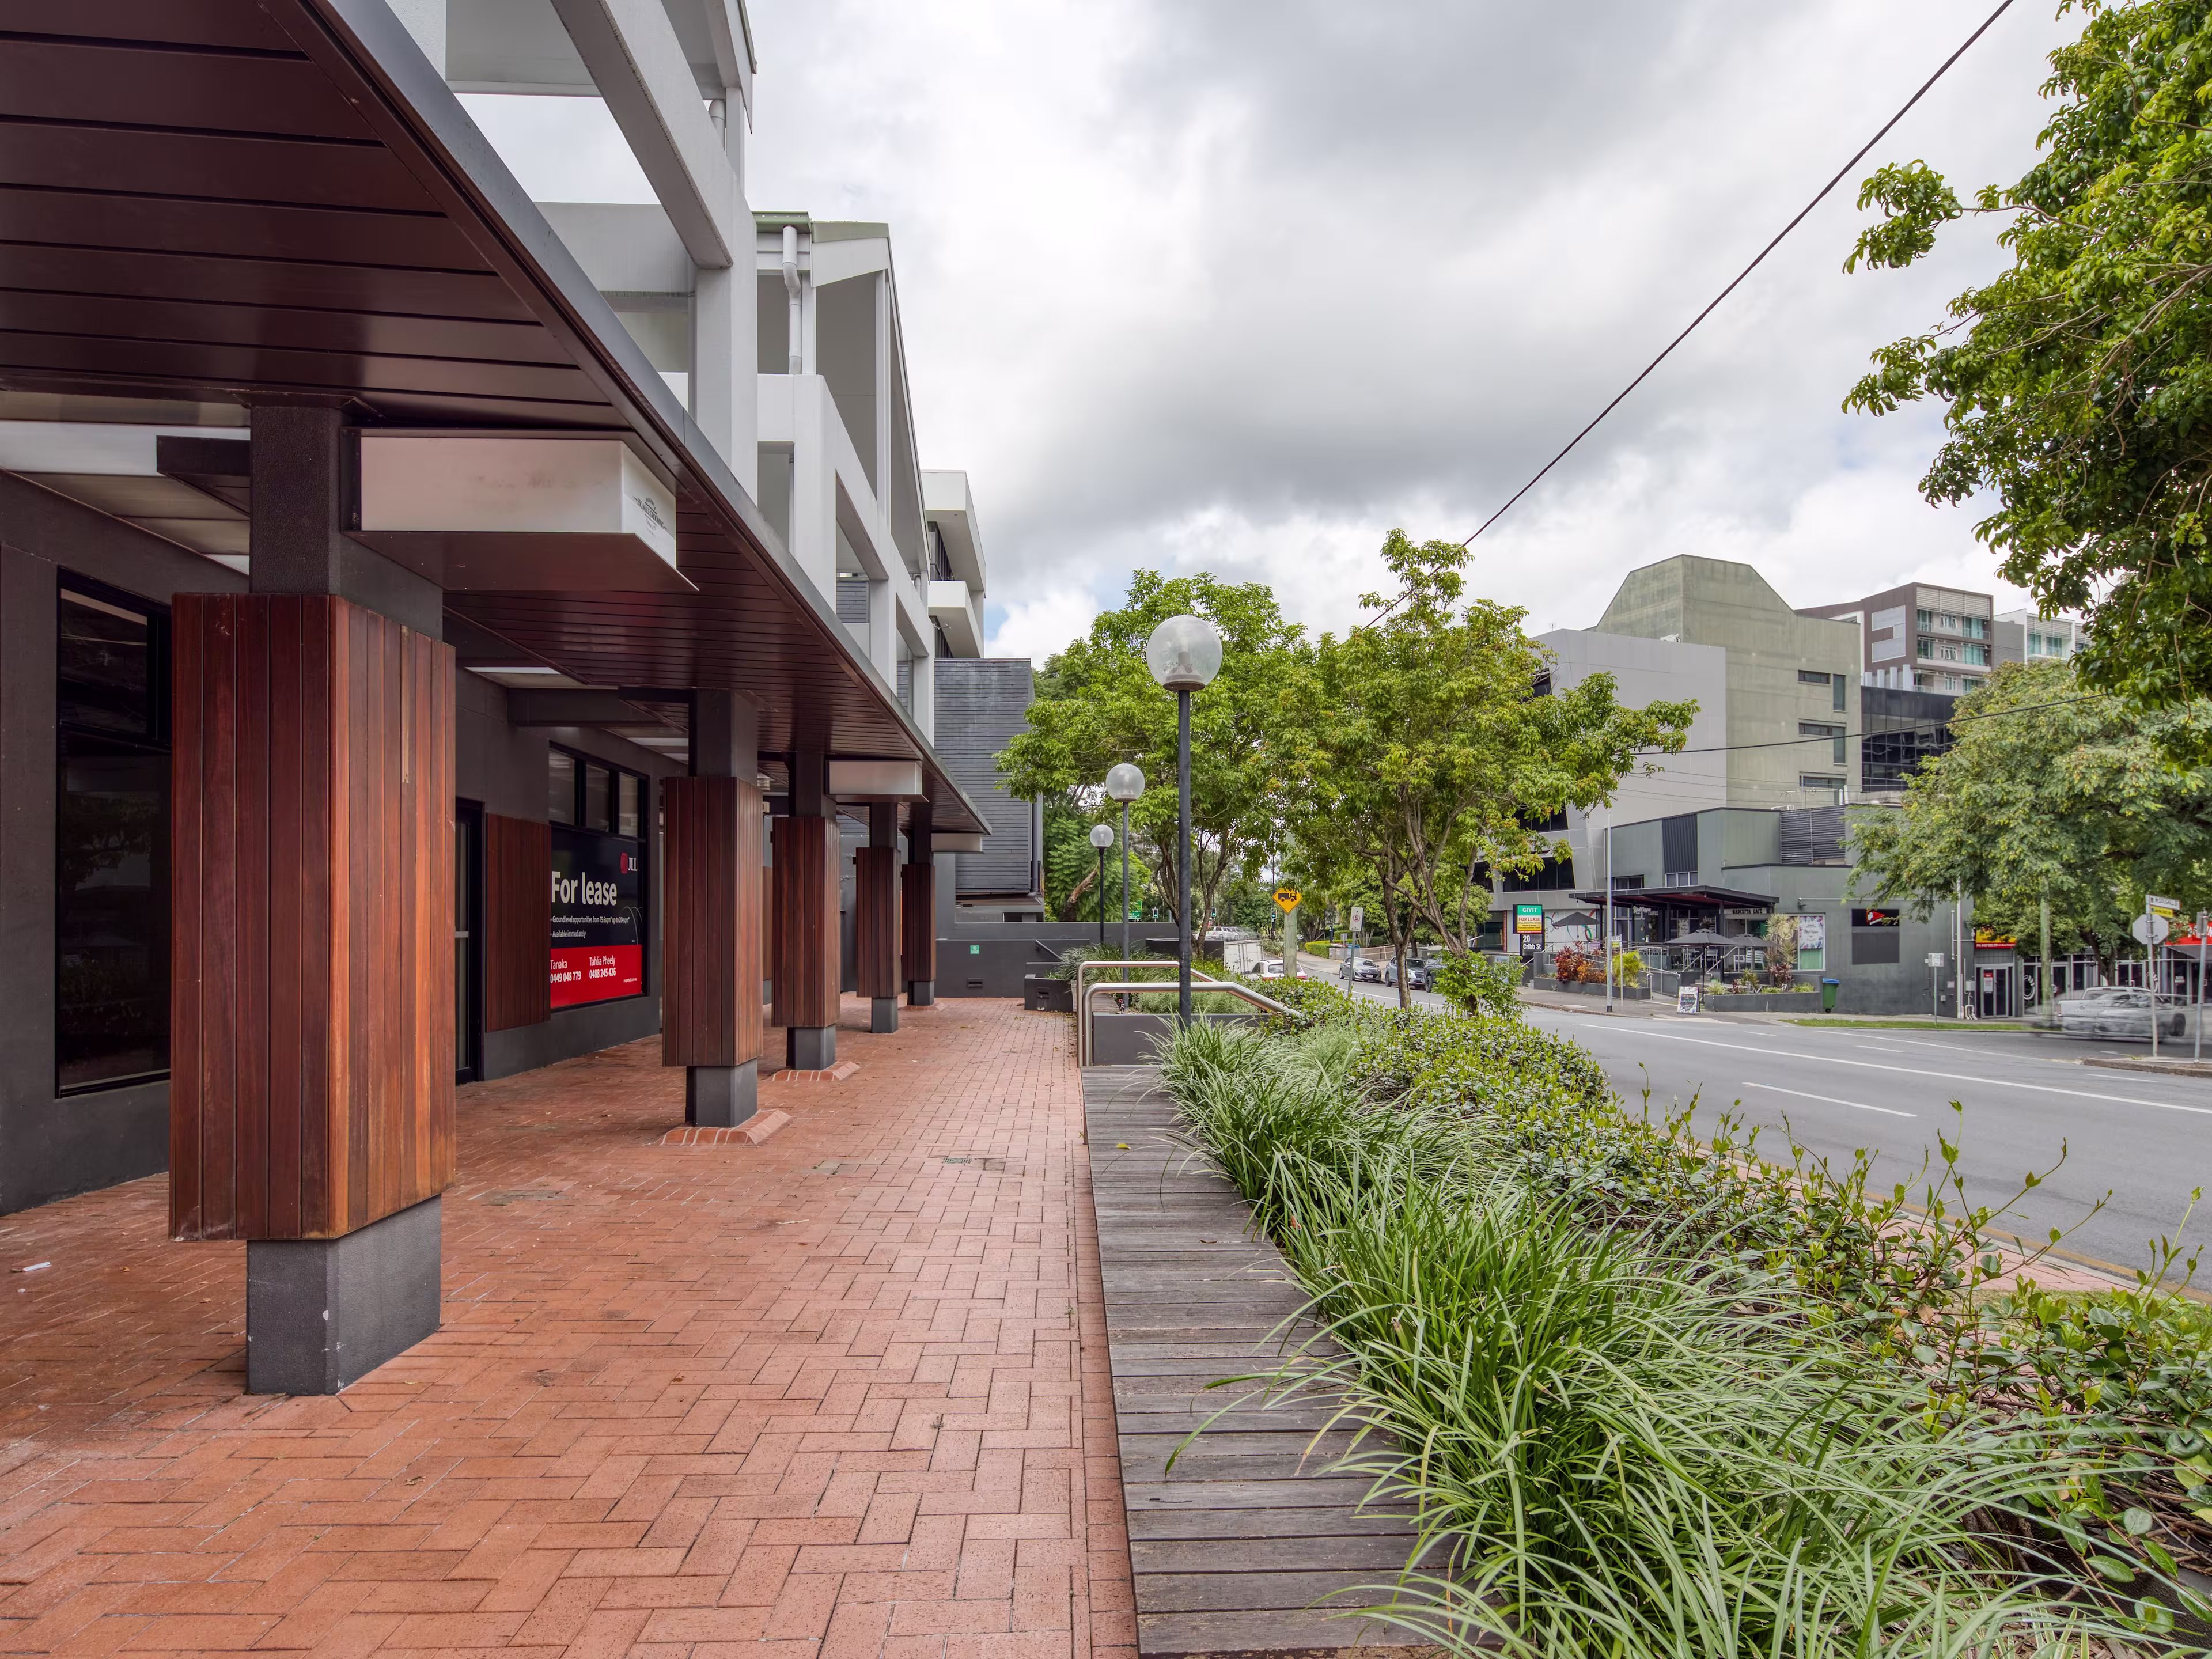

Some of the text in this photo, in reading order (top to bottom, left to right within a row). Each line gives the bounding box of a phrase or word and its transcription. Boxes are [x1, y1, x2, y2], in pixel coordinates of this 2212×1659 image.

[627, 857, 638, 871] JLL
[551, 870, 617, 906] For lease
[573, 916, 592, 924] opportunities
[567, 930, 586, 938] immediately
[550, 959, 567, 970] Tanaka
[589, 955, 616, 967] Tahlia Pheely
[550, 971, 581, 984] 0449 048 779
[589, 967, 616, 979] 0488 245 426
